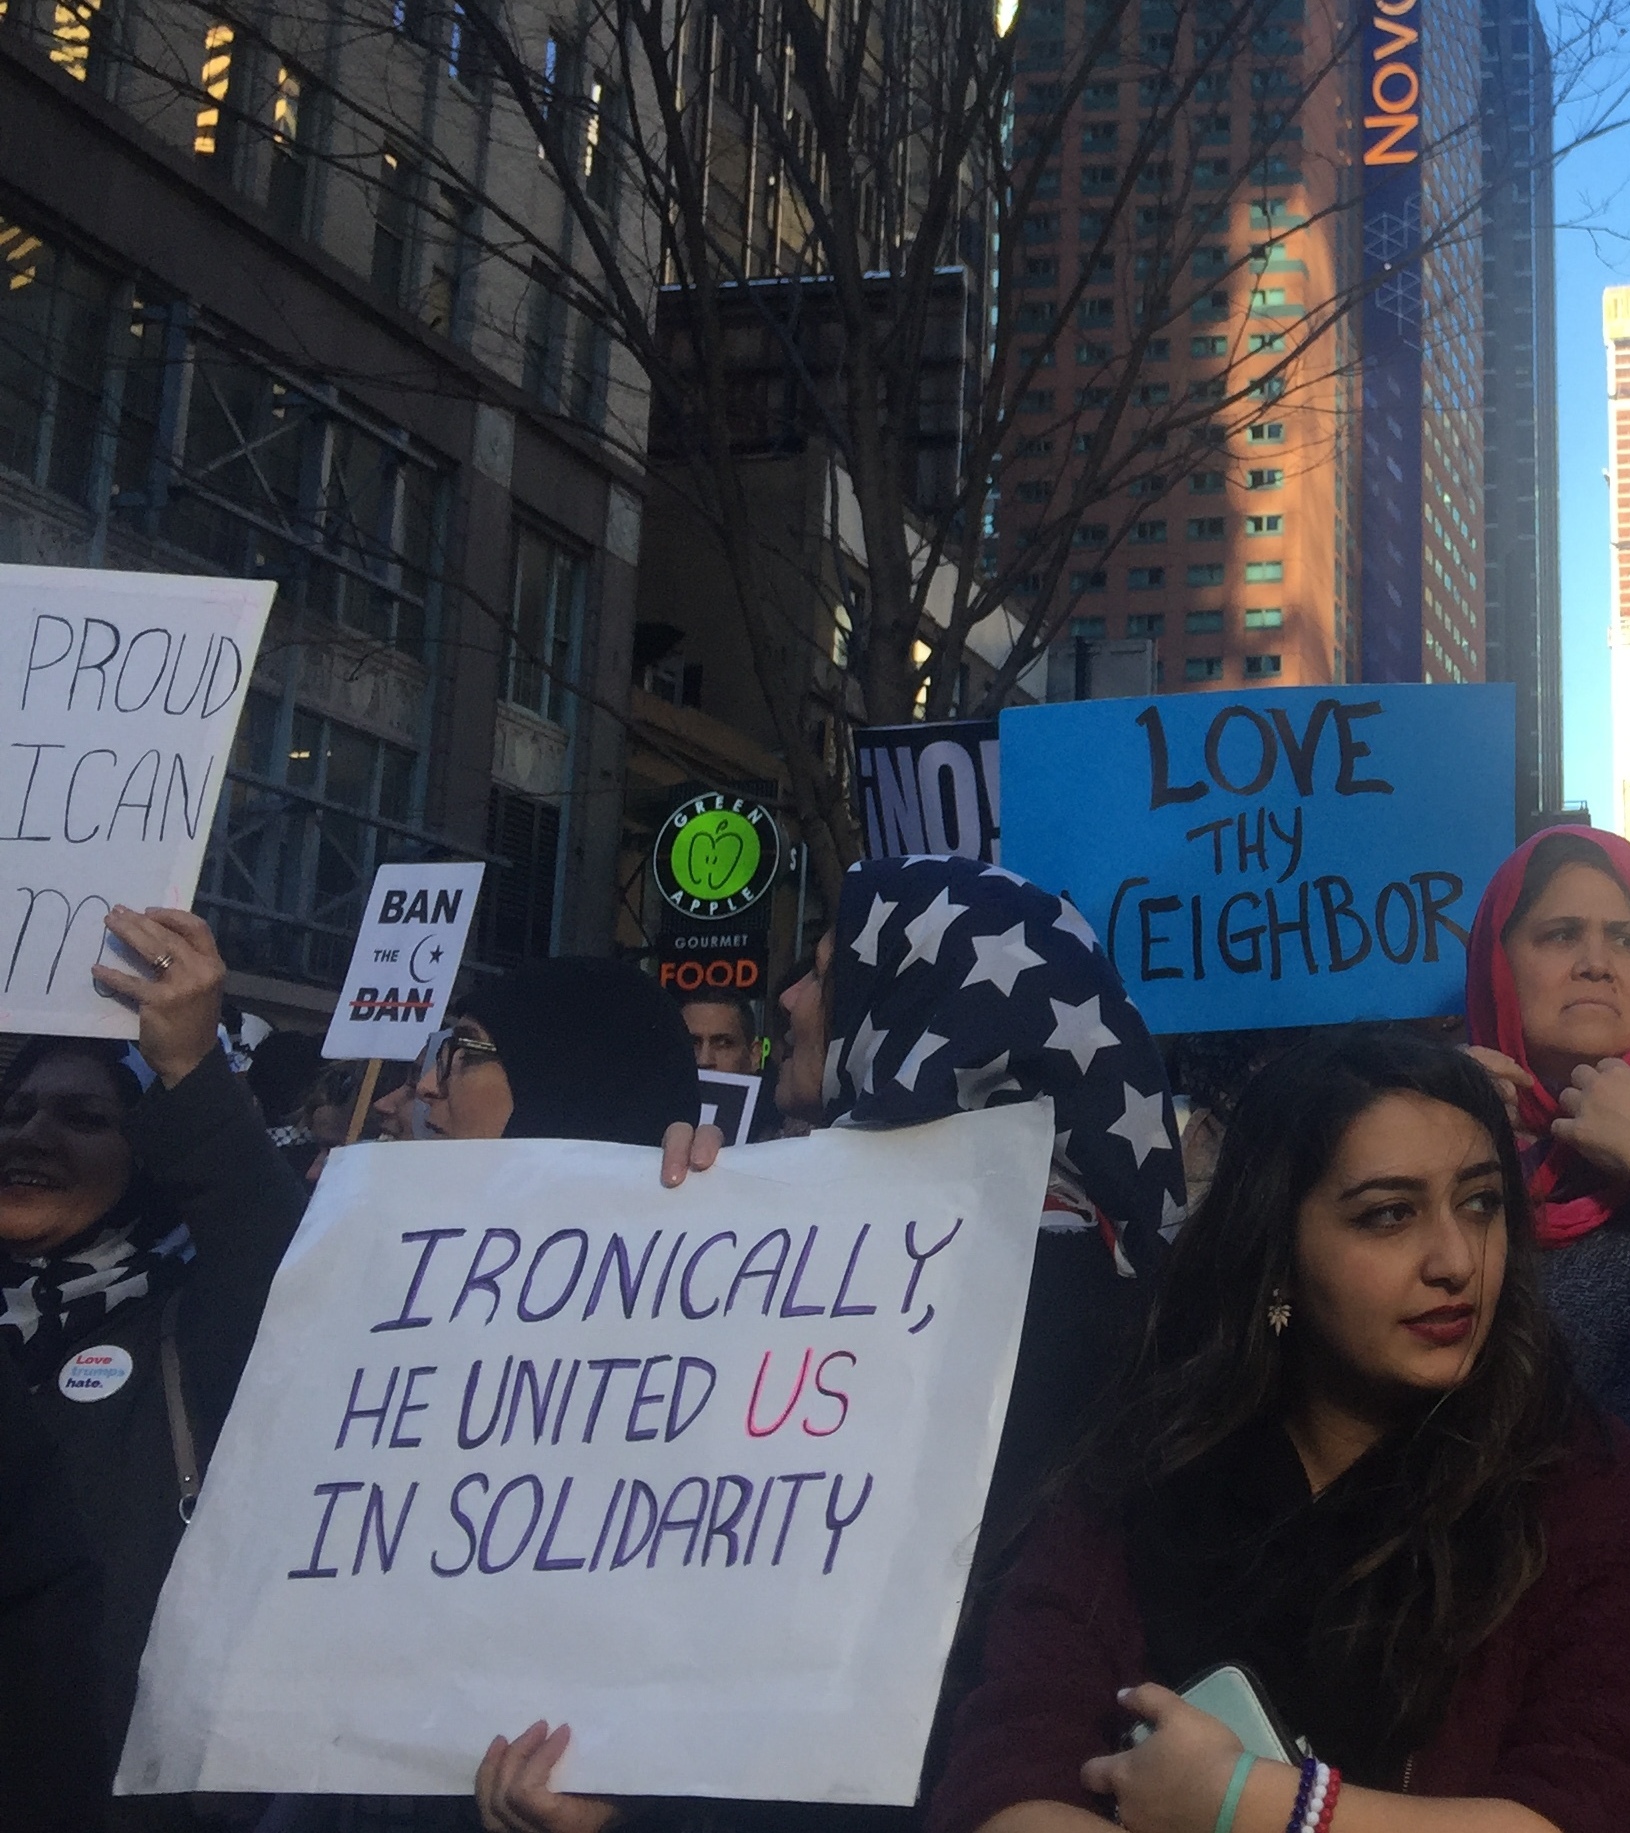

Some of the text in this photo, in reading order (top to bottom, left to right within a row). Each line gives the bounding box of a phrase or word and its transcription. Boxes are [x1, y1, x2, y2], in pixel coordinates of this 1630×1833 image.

[21, 614, 243, 719] PROUD
[1135, 698, 1395, 811] LOVE
[673, 795, 763, 828] GREEN
[1186, 806, 1304, 878] THY
[378, 889, 463, 924] BAN
[670, 887, 755, 916] APPLE
[373, 949, 400, 963] THE
[674, 934, 749, 949] GOURMET
[659, 958, 760, 990] FOOD
[349, 987, 434, 1023] BAN
[371, 1218, 963, 1334] IRONICALLY,
[75, 1354, 113, 1365] Love
[65, 1377, 104, 1389] hate.
[335, 1347, 858, 1452] HE UNITED US
[287, 1471, 873, 1580] IN SOLIDARITY
